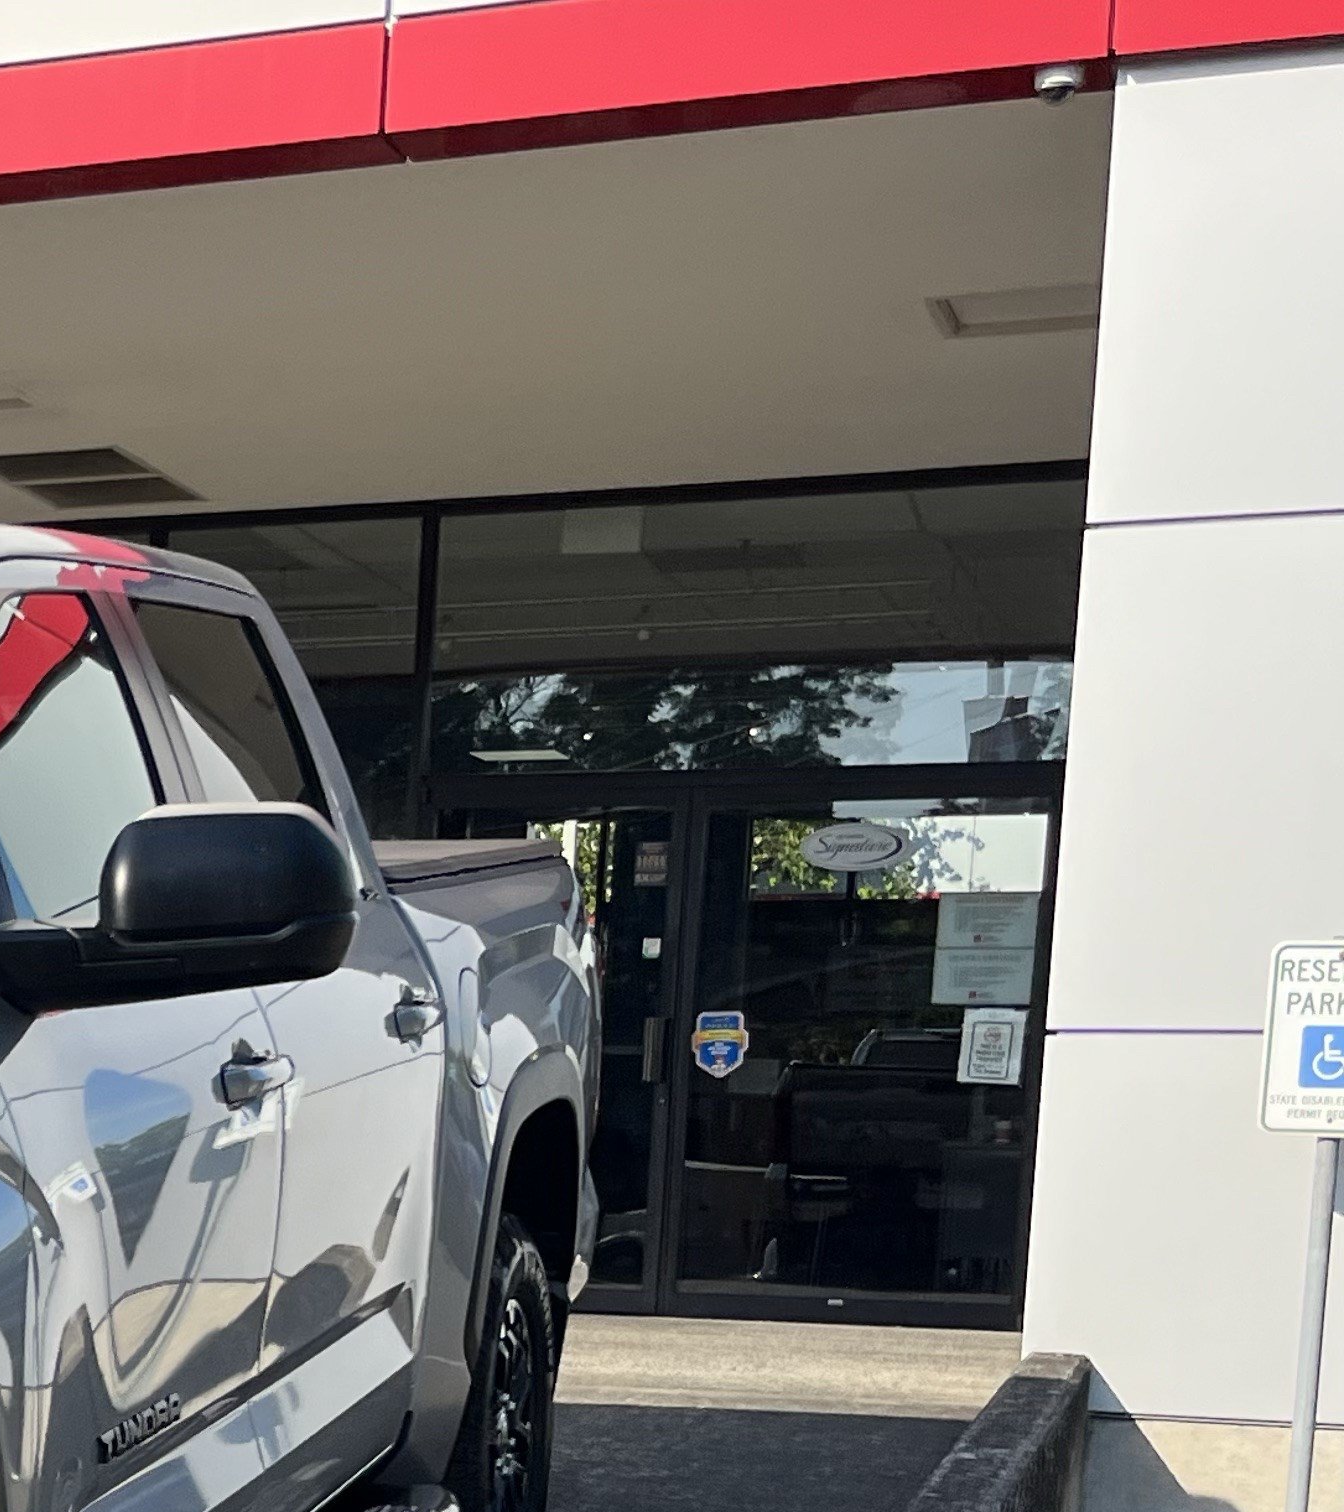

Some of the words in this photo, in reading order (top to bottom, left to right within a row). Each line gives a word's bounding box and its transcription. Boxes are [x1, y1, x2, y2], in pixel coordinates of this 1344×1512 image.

[1280, 958, 1344, 982] RESE
[1269, 1094, 1298, 1105] STATE
[1301, 1095, 1344, 1106] DISABLE
[97, 1392, 181, 1463] TUNDRA
